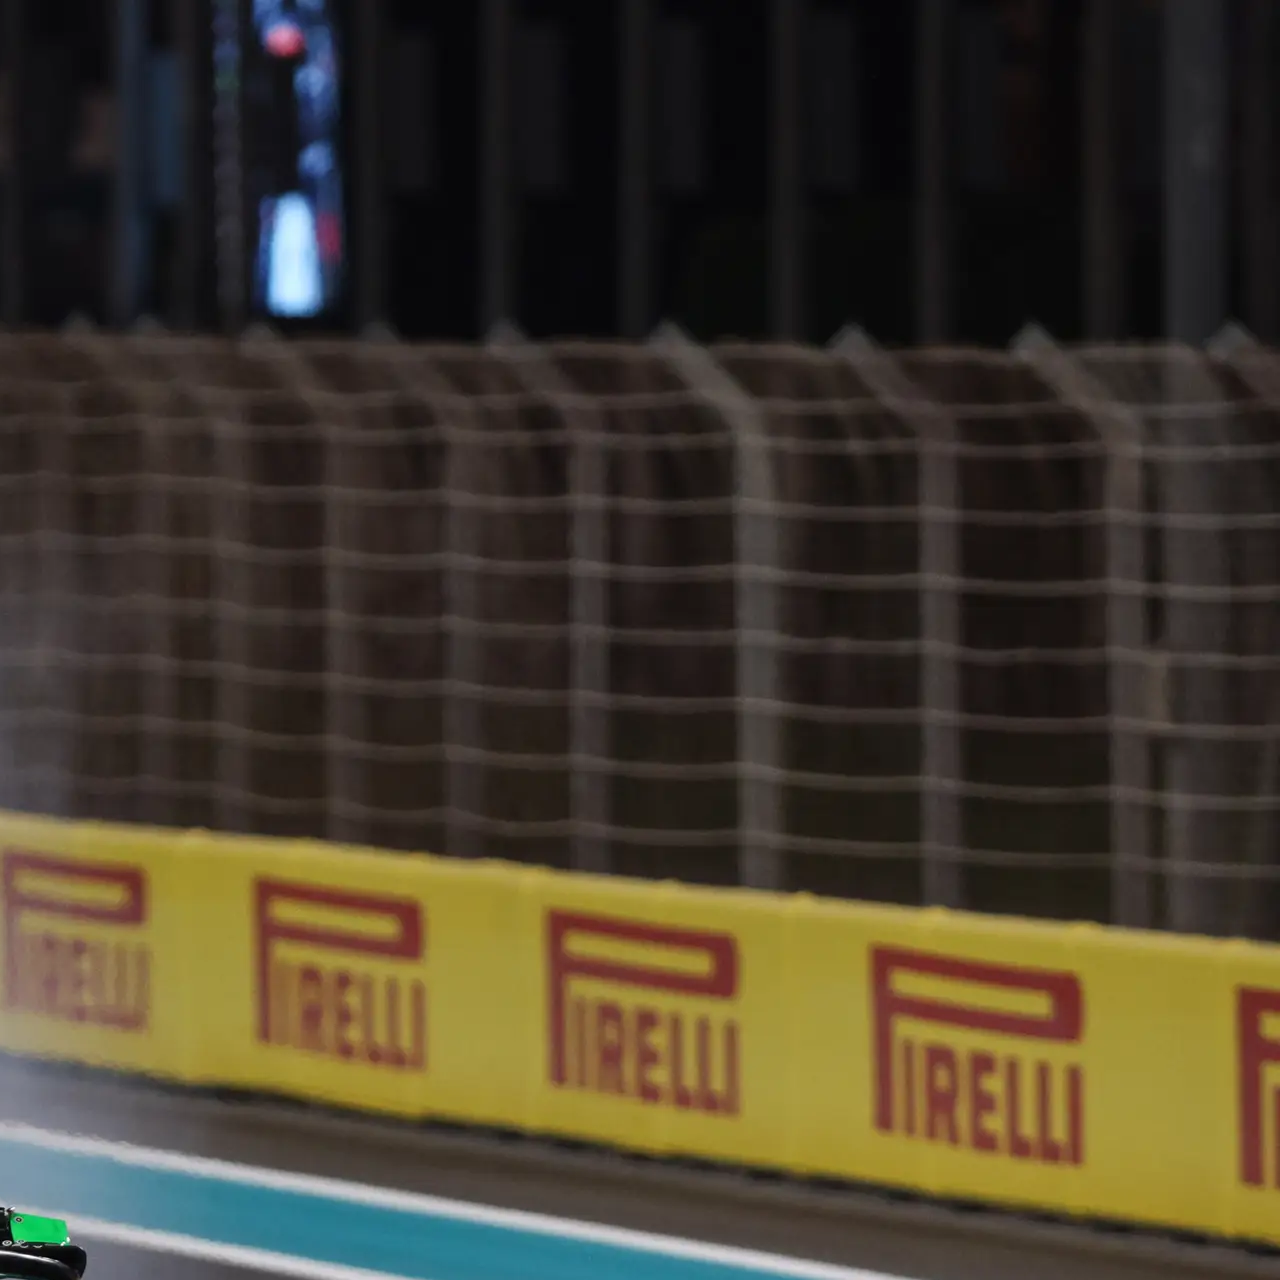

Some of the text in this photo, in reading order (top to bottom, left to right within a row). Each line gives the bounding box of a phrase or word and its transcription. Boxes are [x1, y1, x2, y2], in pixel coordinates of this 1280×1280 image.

[1, 847, 150, 1031] PIRELLI
[254, 876, 427, 1070] PIRELLI
[547, 908, 739, 1116] PIRELLI
[870, 943, 1084, 1166] PIRELLI
